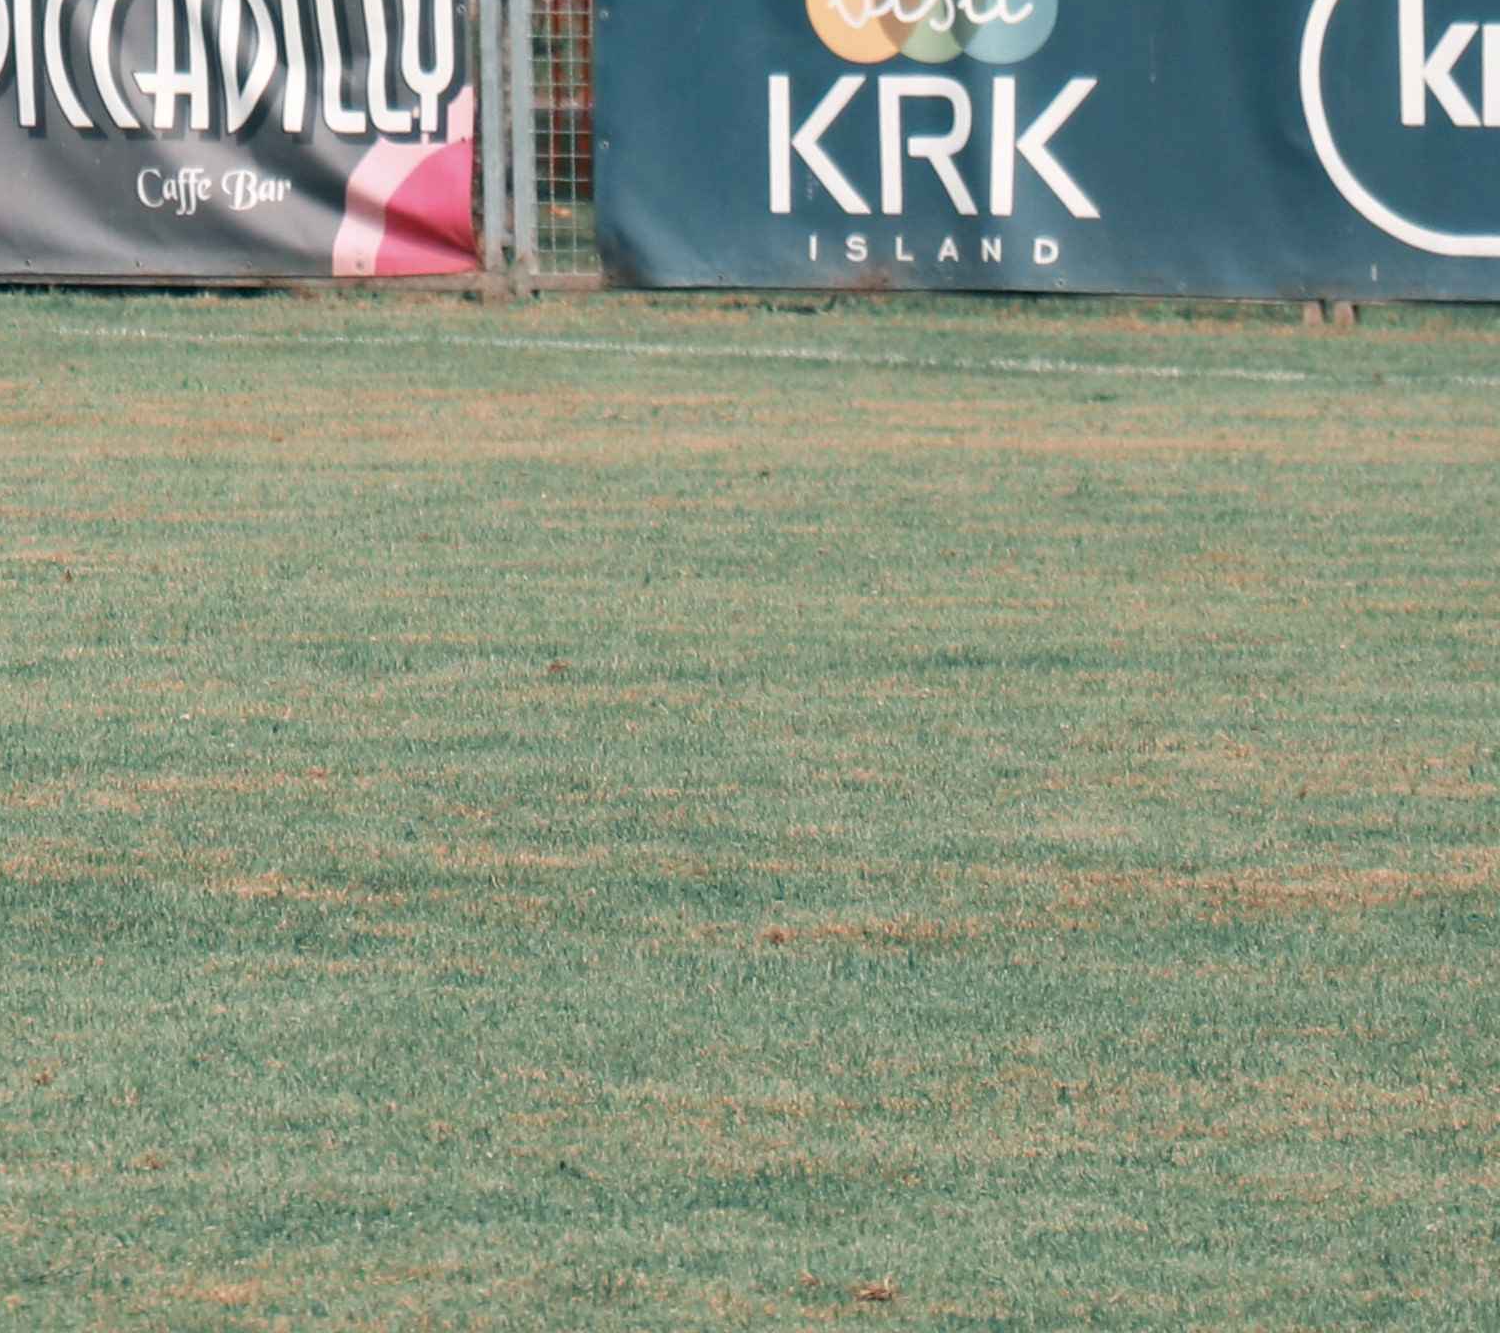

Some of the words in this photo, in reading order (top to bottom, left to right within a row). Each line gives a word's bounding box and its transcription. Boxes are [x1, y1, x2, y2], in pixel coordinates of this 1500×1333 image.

[768, 74, 1102, 219] KRK
[136, 166, 213, 216] Caffe
[221, 168, 292, 211] Bar
[808, 234, 1060, 266] ISLAND
